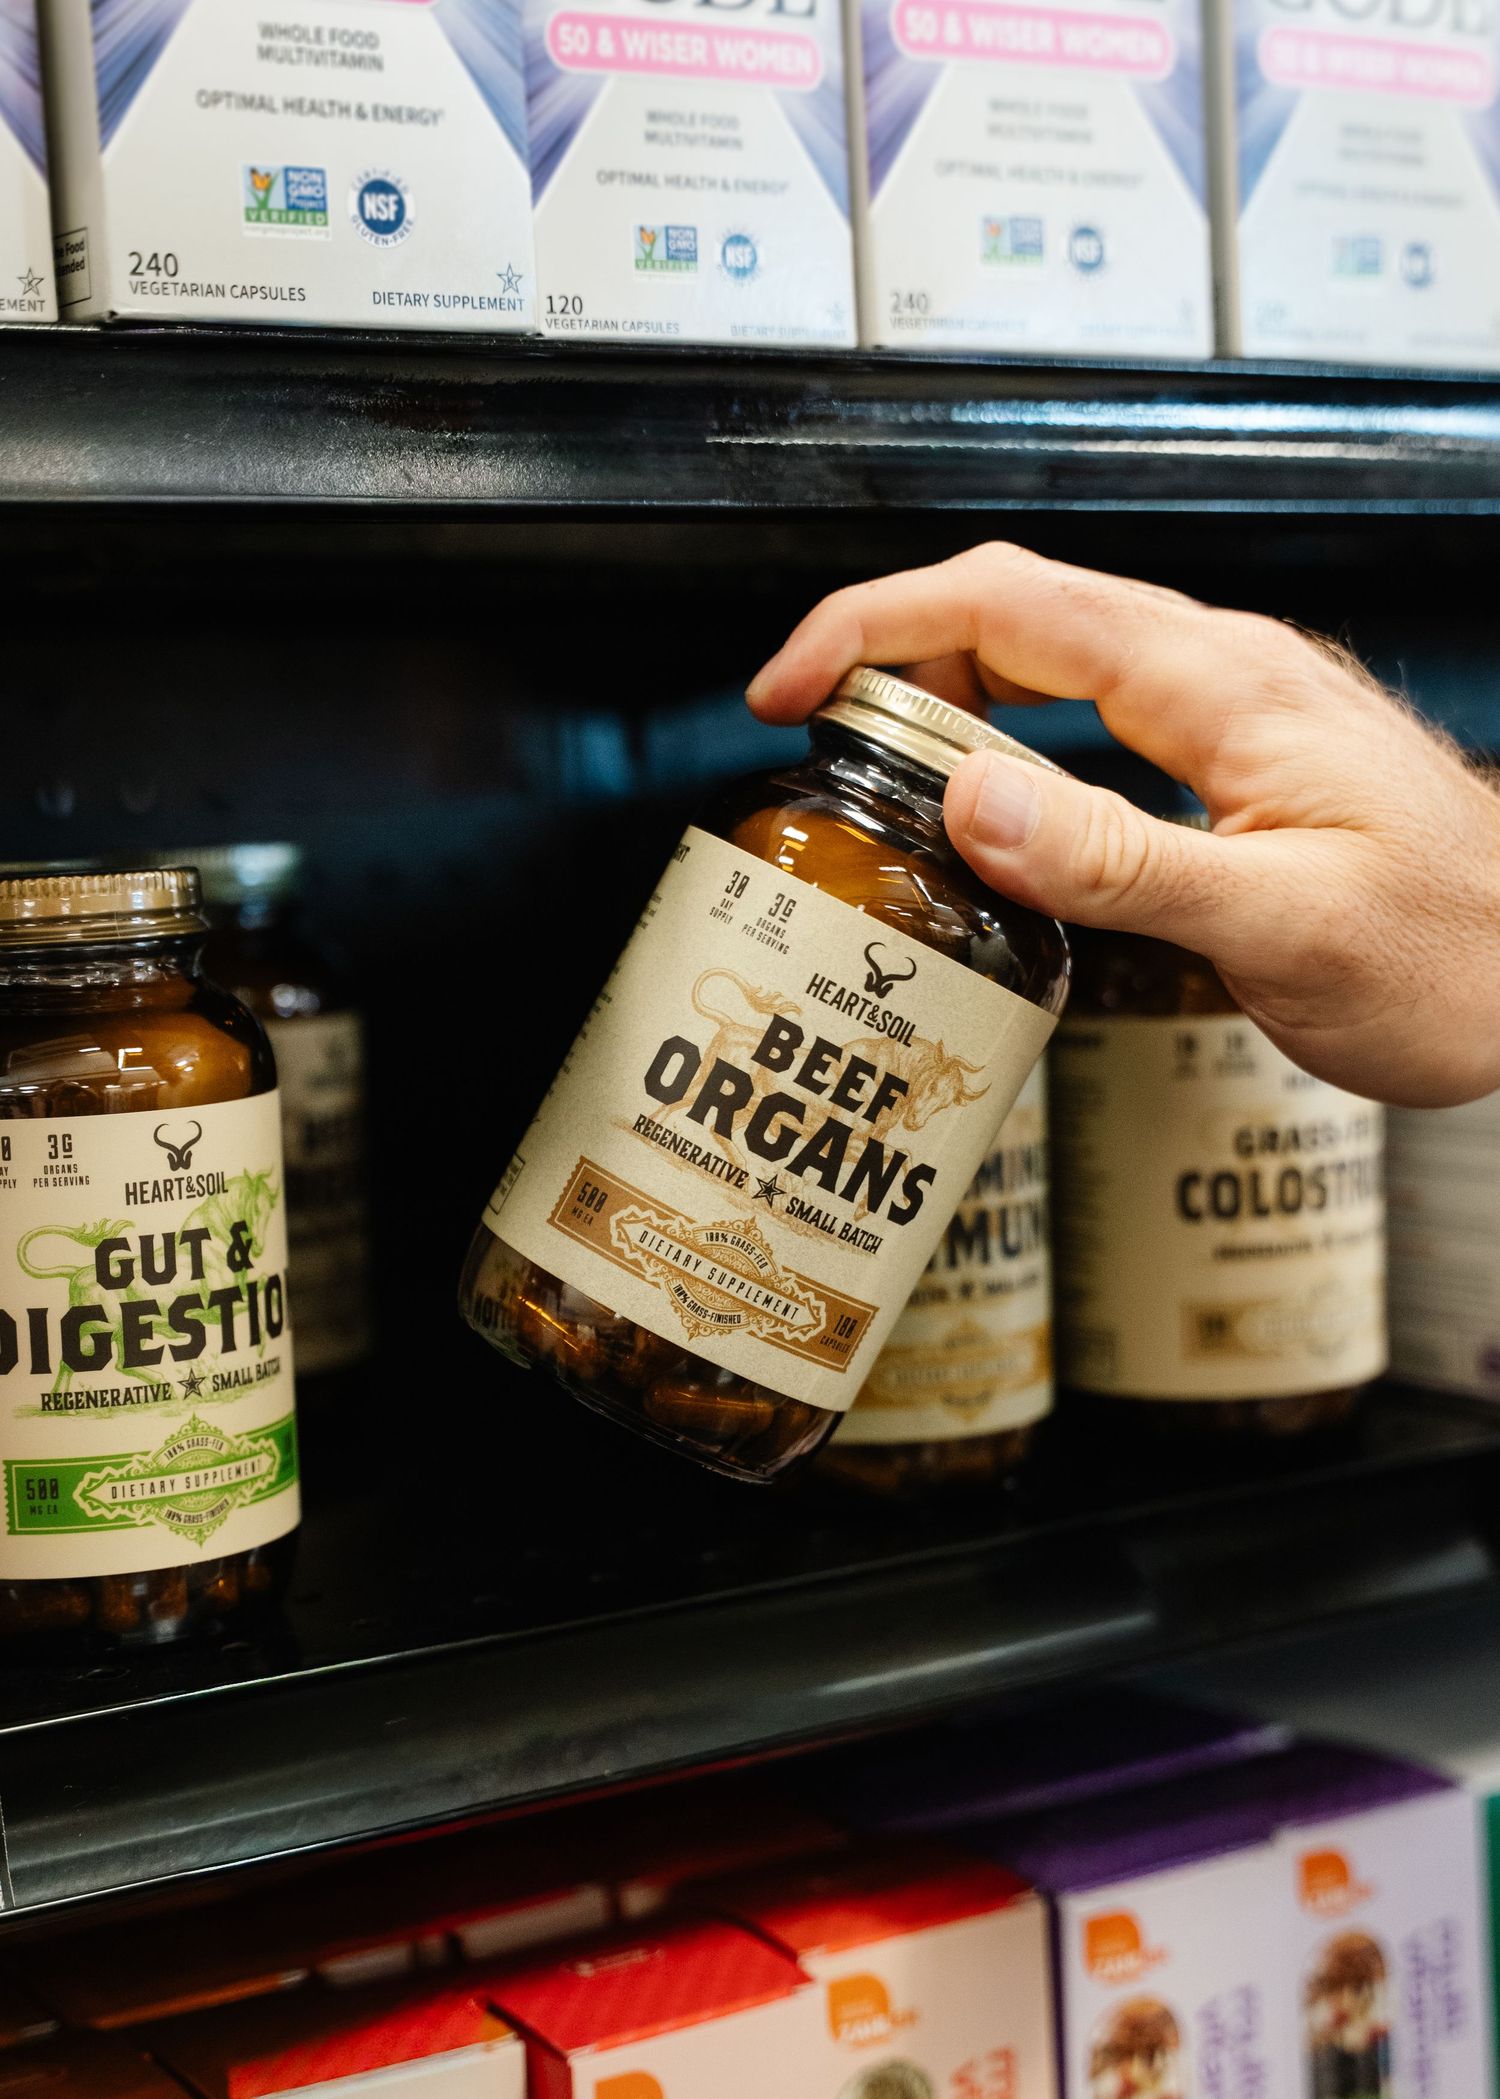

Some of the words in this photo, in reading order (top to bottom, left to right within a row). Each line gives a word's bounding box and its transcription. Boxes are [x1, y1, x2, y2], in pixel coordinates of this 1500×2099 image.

[258, 22, 324, 46] WHOLE
[328, 28, 380, 51] FOOD
[557, 22, 590, 56] 50
[597, 26, 616, 59] &
[620, 28, 708, 65] WISER
[713, 38, 814, 75] WOMEN
[257, 44, 385, 72] MULTIVITAMIN
[196, 88, 278, 115] OPTIMAL
[282, 96, 350, 120] HEALTH
[353, 102, 368, 121] &
[288, 182, 324, 199] GMO
[596, 169, 660, 188] OPTIMAL
[663, 173, 718, 190] HEALTH
[248, 208, 326, 225] VERIFIED
[363, 192, 399, 221] NSF
[65, 237, 85, 256] Food
[129, 251, 180, 278] 240
[128, 281, 226, 299] VEGETARIAN
[229, 285, 307, 302] CAPSULES
[372, 291, 431, 308] DIETARY
[433, 294, 524, 312] SUPPLEMENT
[889, 291, 929, 315] 240
[545, 295, 584, 316] 120
[545, 318, 619, 332] VEGETARIAN
[621, 320, 681, 335] CAPSULES
[725, 870, 750, 899] 30
[709, 906, 734, 925] SUPPLY
[720, 898, 734, 911] DAY
[768, 893, 797, 923] 3G
[741, 923, 757, 938] PER
[756, 931, 790, 955] SERVING
[756, 916, 787, 939] ORGANS
[750, 1013, 910, 1125] BEEF
[643, 1035, 938, 1227] ORGANS
[47, 1133, 73, 1159] 3G
[33, 1177, 49, 1188] PER
[52, 1175, 90, 1188] SERVING
[43, 1163, 79, 1175] ORGANS
[576, 1182, 608, 1213] 500
[632, 1113, 750, 1191] REGENERATIVE
[785, 1196, 837, 1235] SMALL
[837, 1221, 884, 1255] BATCH
[94, 1226, 213, 1291] GUT
[226, 1219, 255, 1273] &
[730, 1235, 769, 1270] GRASS-FED
[638, 1229, 703, 1273] DIETARY
[706, 1266, 800, 1321] SUPPLEMENT
[685, 1297, 742, 1325] GRASS-FINISHED
[41, 1382, 172, 1412] REGENERATIVE
[212, 1366, 254, 1393] SMALL
[186, 1436, 225, 1452] GRASS-FED
[25, 1476, 60, 1501] 500
[110, 1478, 176, 1500] DIETARY
[185, 1459, 261, 1490] SUPPLEMENT
